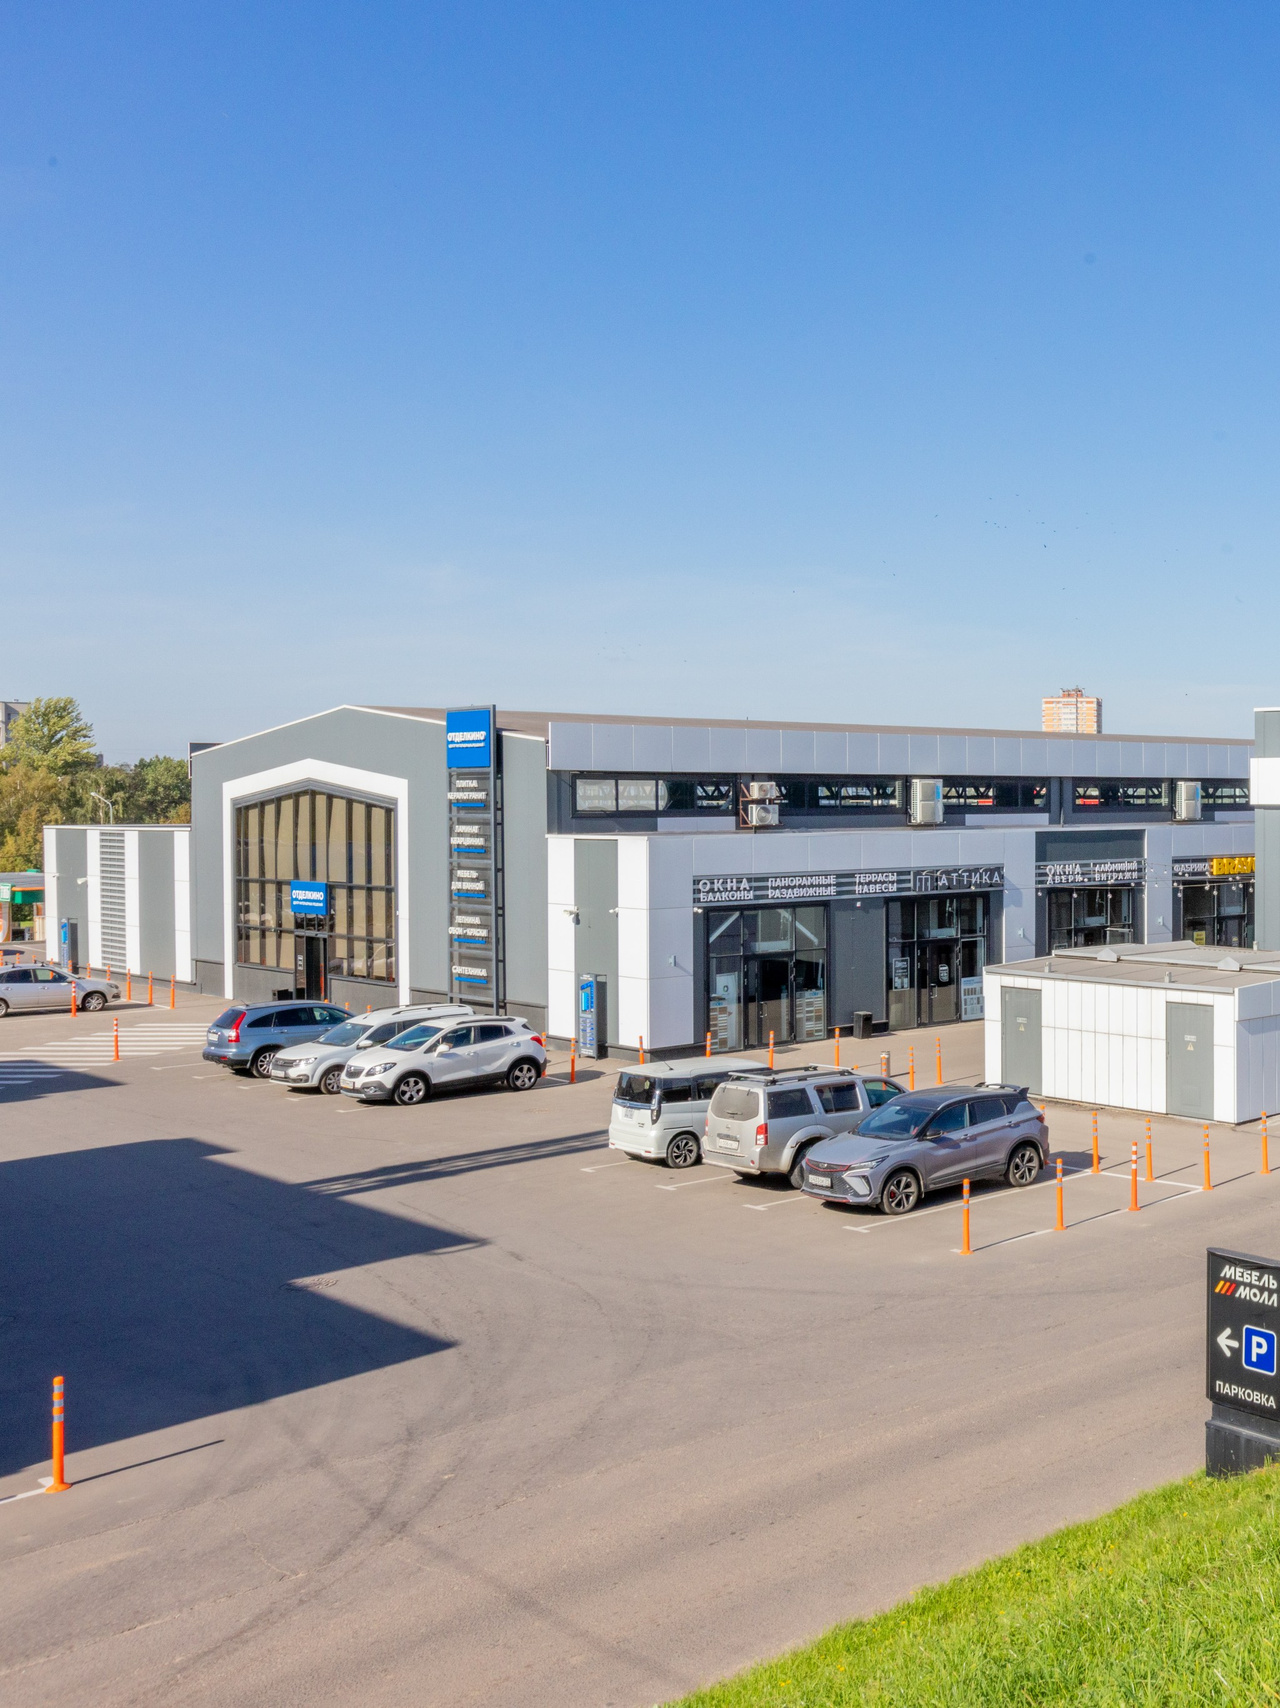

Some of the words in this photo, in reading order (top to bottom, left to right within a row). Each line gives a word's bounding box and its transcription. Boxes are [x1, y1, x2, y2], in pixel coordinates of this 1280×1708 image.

[1046, 864, 1081, 875] ОКНА
[1095, 861, 1137, 872] АЛЮМИНИЙ
[1173, 863, 1210, 872] ФАБРИКА
[1213, 857, 1255, 876] BRAV
[768, 875, 837, 888] ПАНОРАМНЫЕ
[855, 873, 897, 883] ТЕРРАСЫ
[940, 872, 1000, 886] АТТИКА
[1095, 872, 1137, 881] ВИТРАЖИ
[699, 878, 750, 891] ОКНА
[855, 883, 897, 894] НАВЕСЫ
[292, 890, 324, 900] ОТДЕЛКИНО
[700, 890, 754, 902] БАЛКОНЫ
[768, 886, 837, 899] РАЗДВИЖНЫЕ
[1220, 1265, 1278, 1290] МЕБЕЛЬ
[1235, 1285, 1278, 1307] МОЛЛ
[1215, 1380, 1277, 1409] ПАРКОВКА
